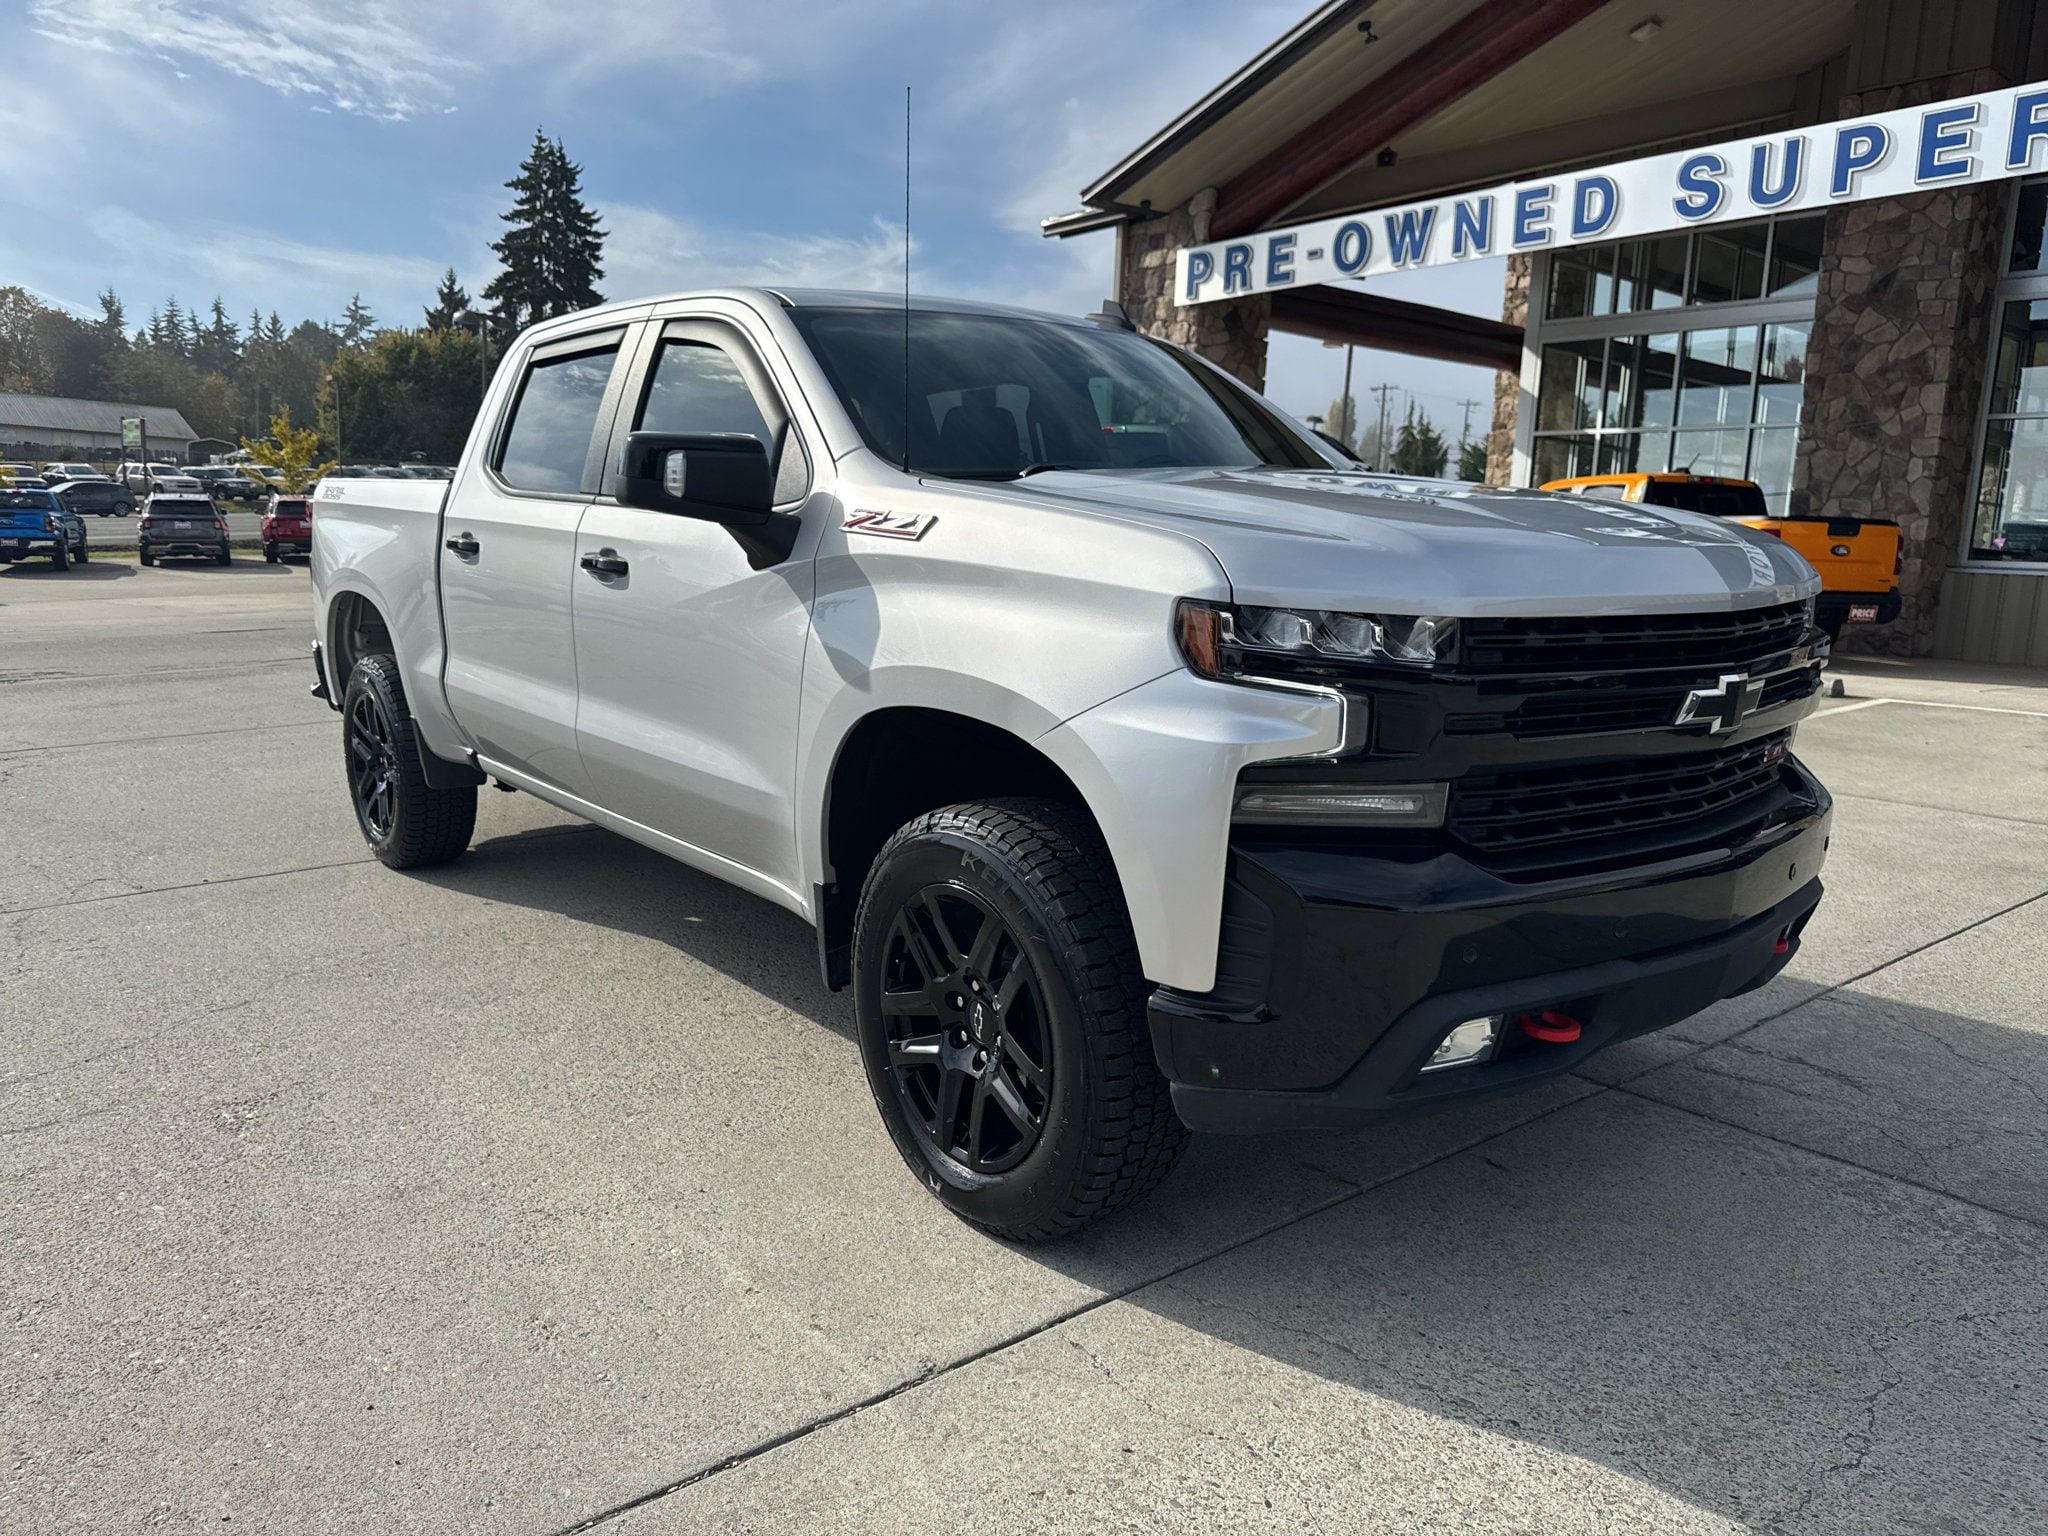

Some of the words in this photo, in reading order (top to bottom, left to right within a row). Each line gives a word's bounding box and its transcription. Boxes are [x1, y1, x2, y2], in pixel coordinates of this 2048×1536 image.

[1186, 174, 1619, 300] PRE-OWNED
[840, 508, 939, 542] Z71
[1851, 608, 1876, 618] PRICE
